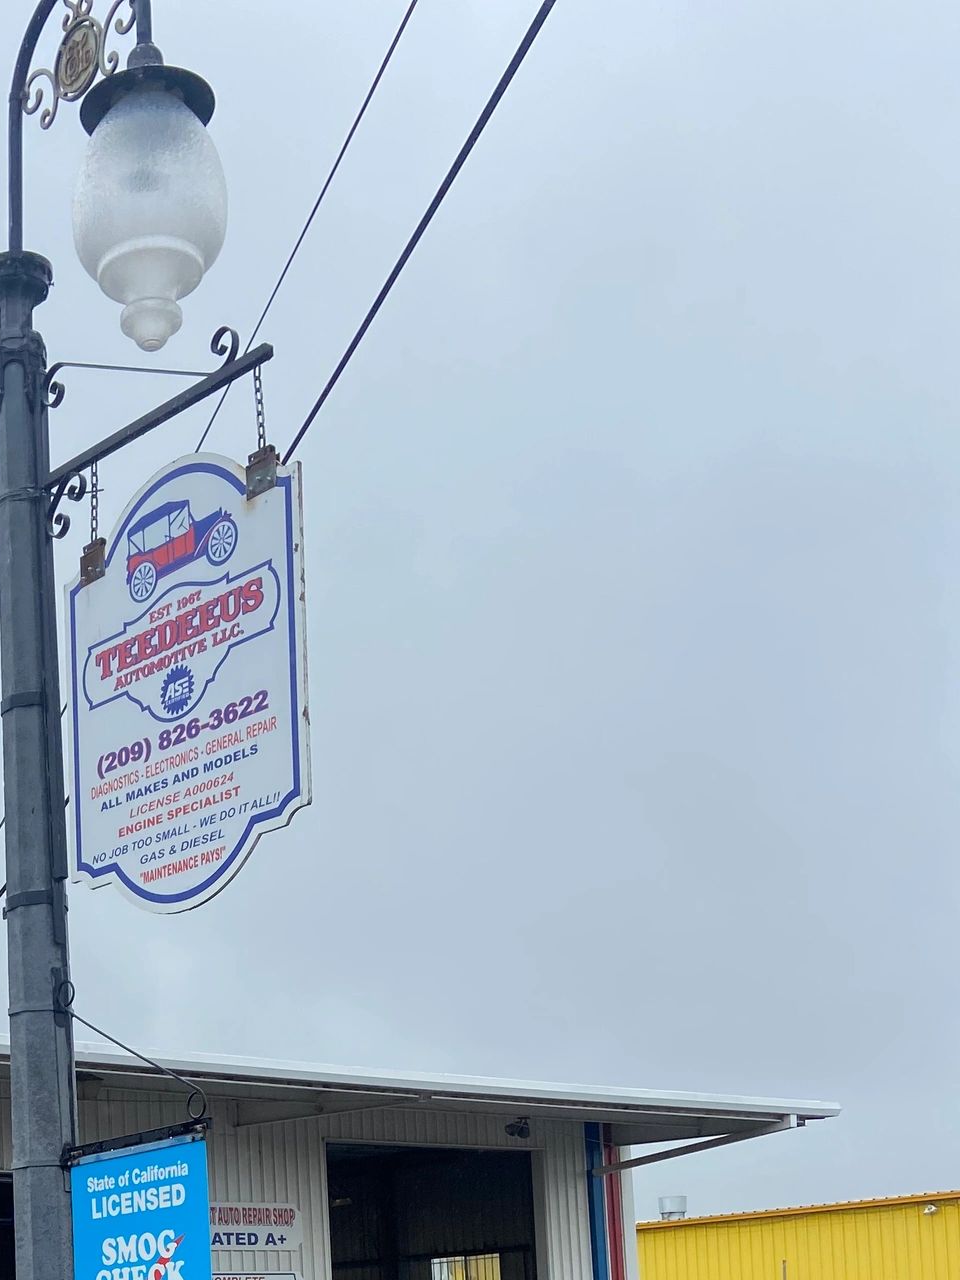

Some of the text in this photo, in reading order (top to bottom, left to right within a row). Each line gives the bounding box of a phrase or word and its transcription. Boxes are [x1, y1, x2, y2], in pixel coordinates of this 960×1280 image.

[149, 590, 202, 624] EST 1967
[95, 577, 264, 680] TEEDEEUS
[114, 623, 244, 691] AUTOMOTIVE LLC.
[165, 676, 189, 700] ASE
[97, 690, 268, 780] (209) 826-3622
[91, 770, 139, 800] DIAGNOSTICS
[146, 747, 198, 778] ELECTRONICS
[206, 730, 244, 756] GENERAL
[246, 716, 276, 740] REPAIR
[100, 744, 258, 812] ALL MAKES AND MODELS
[130, 772, 234, 818] LICENSE A000624
[92, 852, 106, 864] NO
[109, 844, 128, 859] JOB
[132, 836, 152, 851] TOO
[155, 824, 190, 842] SMALL
[200, 814, 216, 828] WE
[220, 808, 236, 821] DO
[239, 802, 249, 814] IT
[250, 792, 280, 810] ALL!!
[118, 786, 240, 838] ENGINE SPECIALIST
[140, 829, 224, 864] GAS & DIESEL
[140, 855, 198, 884] "MAINTENANCE
[87, 1160, 188, 1192] State of California
[91, 1184, 186, 1219] LICENSED
[217, 1207, 240, 1226] AUTO
[242, 1208, 272, 1226] REPAIR
[272, 1208, 296, 1228] SHOP
[102, 1230, 178, 1266] SMOG
[211, 1232, 286, 1246] ATED A+
